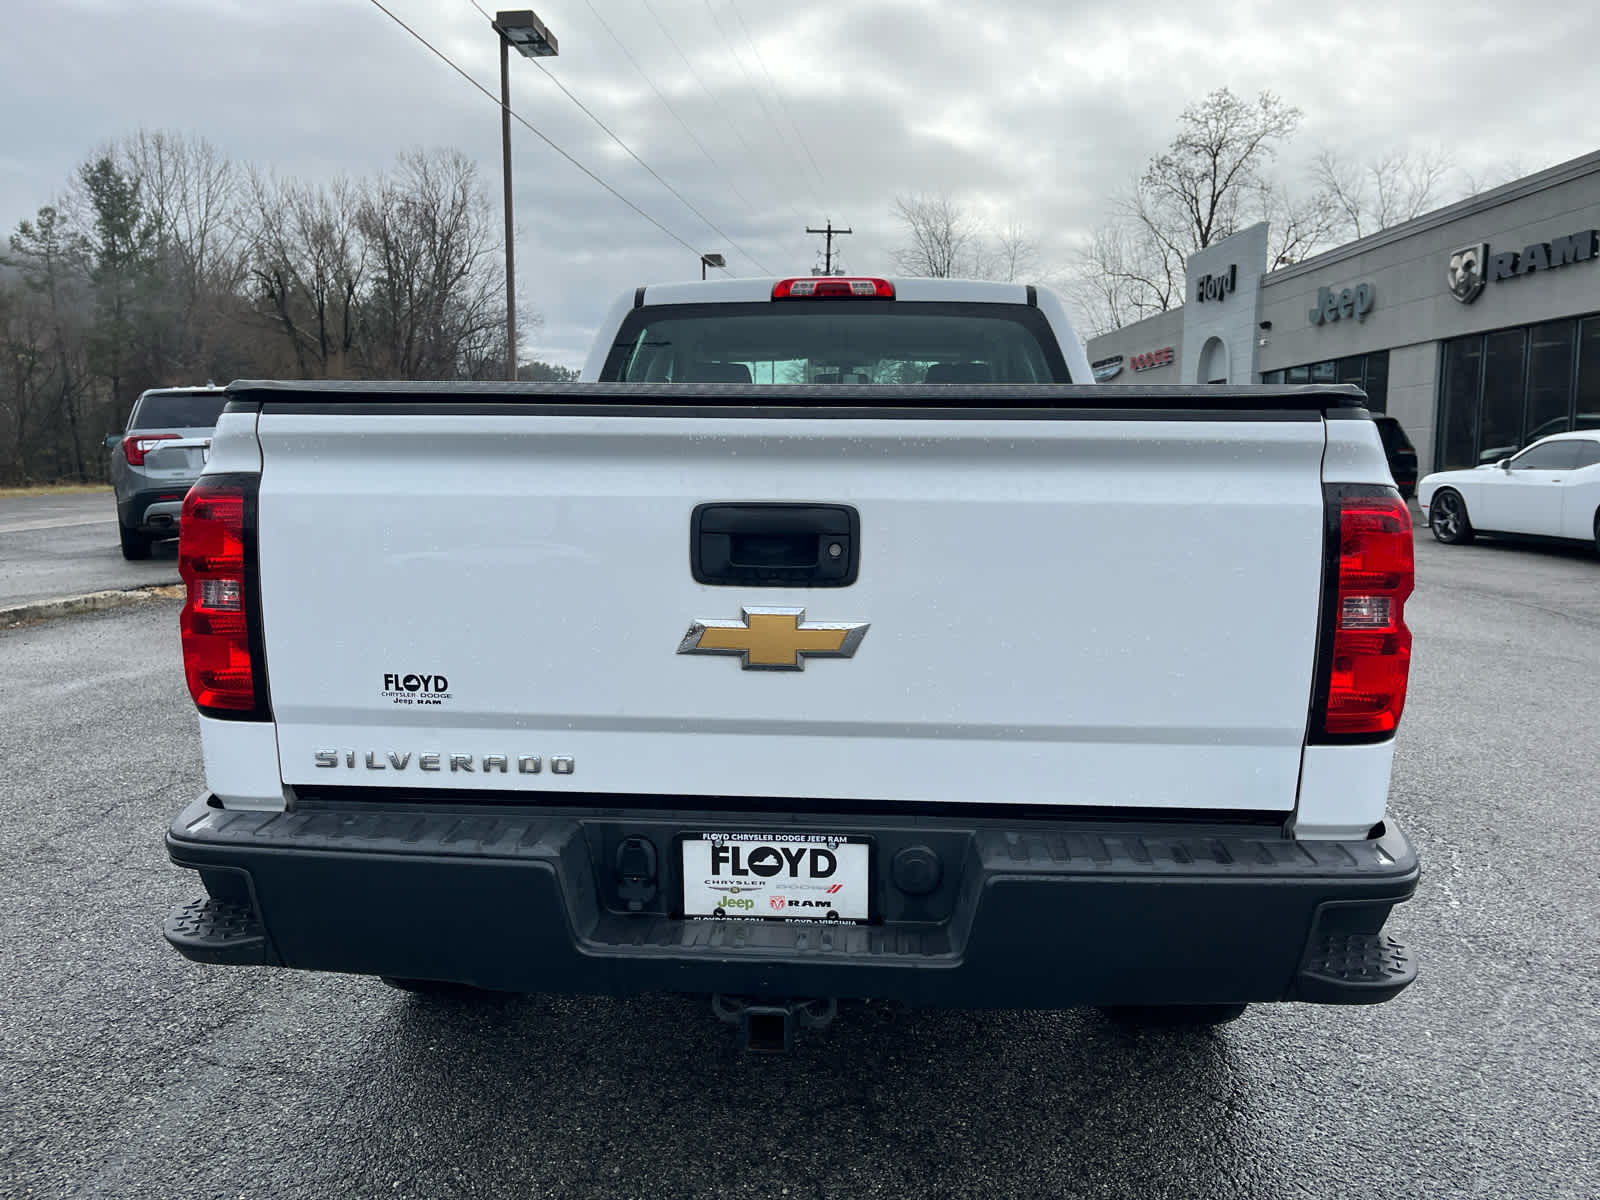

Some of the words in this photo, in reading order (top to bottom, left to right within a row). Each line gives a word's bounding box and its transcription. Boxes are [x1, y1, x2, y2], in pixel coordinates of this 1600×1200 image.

[1488, 229, 1599, 281] RAM
[1198, 264, 1237, 302] Floyd
[1309, 282, 1376, 326] Jeep
[384, 674, 448, 692] FLOYD
[314, 749, 576, 775] SILVERADO
[731, 834, 773, 842] CHRYSLER
[711, 846, 837, 879] FLOYD
[717, 896, 754, 910] Jeep
[788, 900, 832, 908] RAM
